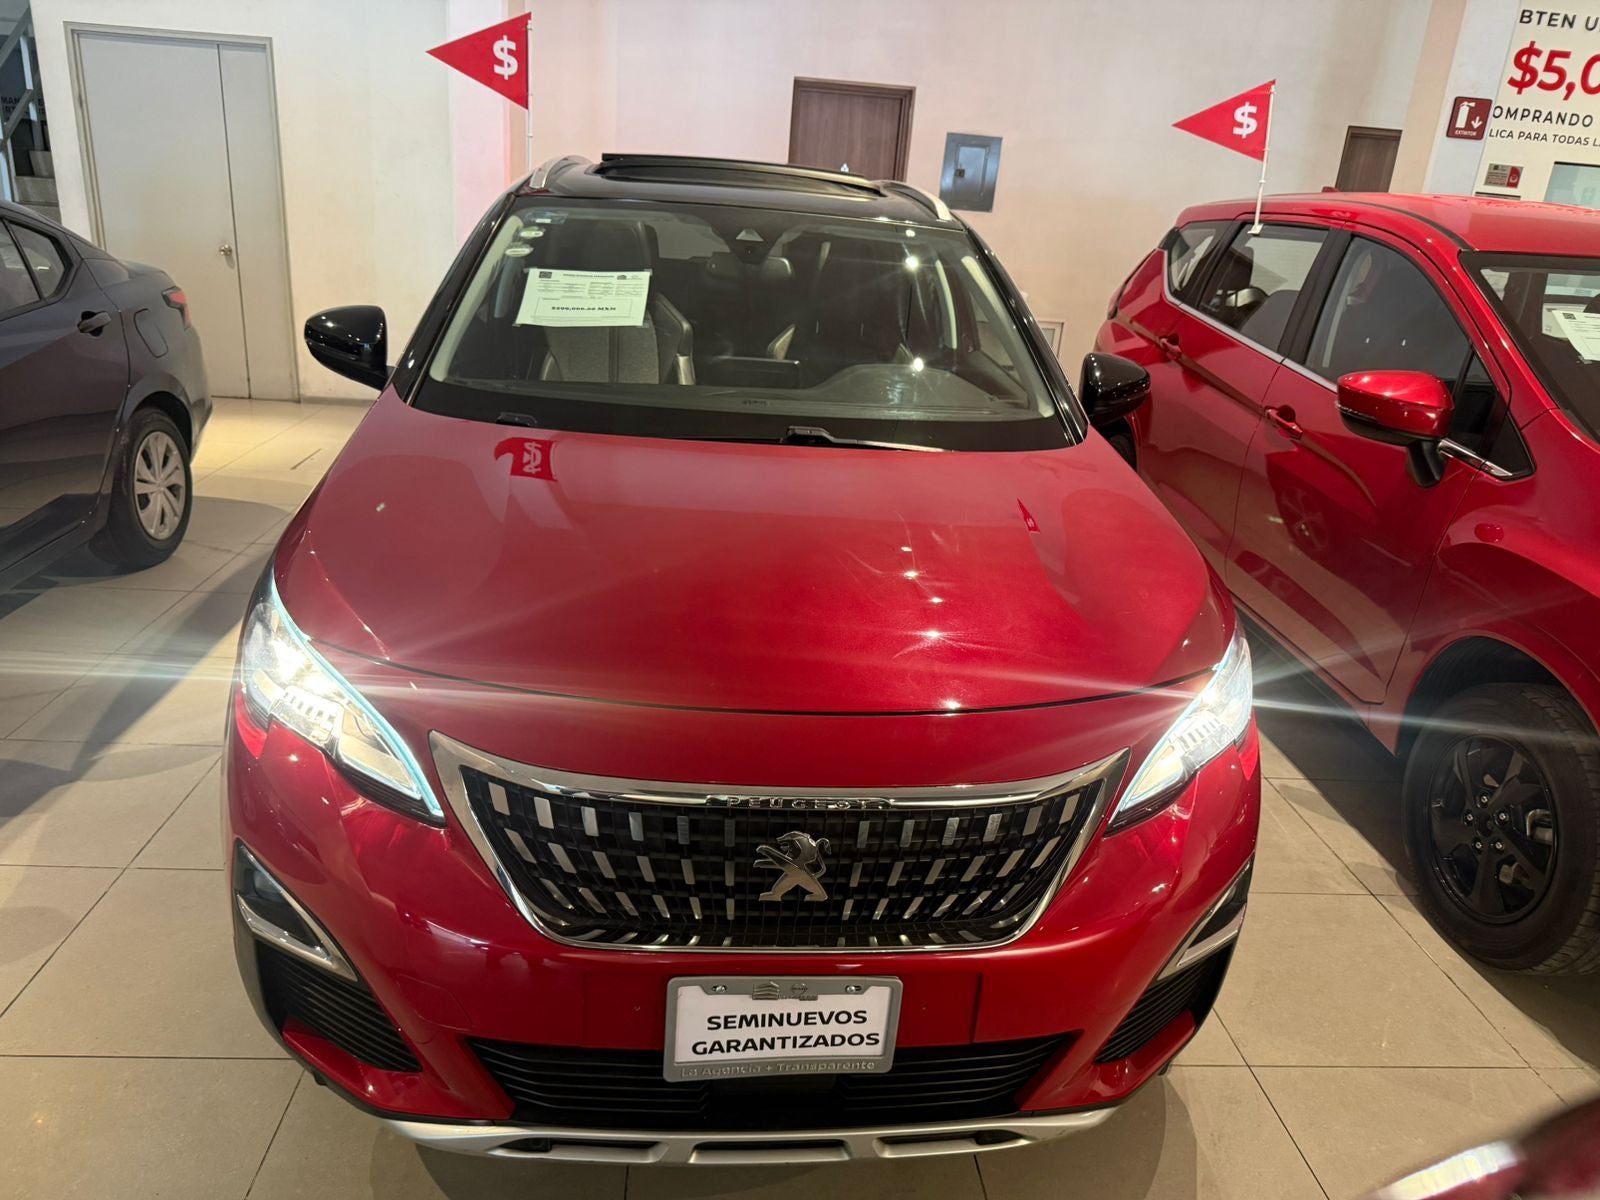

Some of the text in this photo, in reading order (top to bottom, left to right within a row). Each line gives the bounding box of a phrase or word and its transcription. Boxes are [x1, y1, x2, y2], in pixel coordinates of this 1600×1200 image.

[1519, 9, 1600, 32] BTEN U
[493, 35, 518, 80] $
[1232, 101, 1257, 139] $
[1492, 105, 1593, 128] OMPRANDO
[1489, 128, 1600, 147] LICA PARA TODAS L
[726, 796, 869, 810] PEUGEOT
[707, 1010, 867, 1031] SEMINUEVOS
[691, 1033, 880, 1056] GARANTIZADOS
[681, 1066, 698, 1078] La
[701, 1064, 761, 1077] Agencia
[776, 1060, 876, 1073] Transparente
